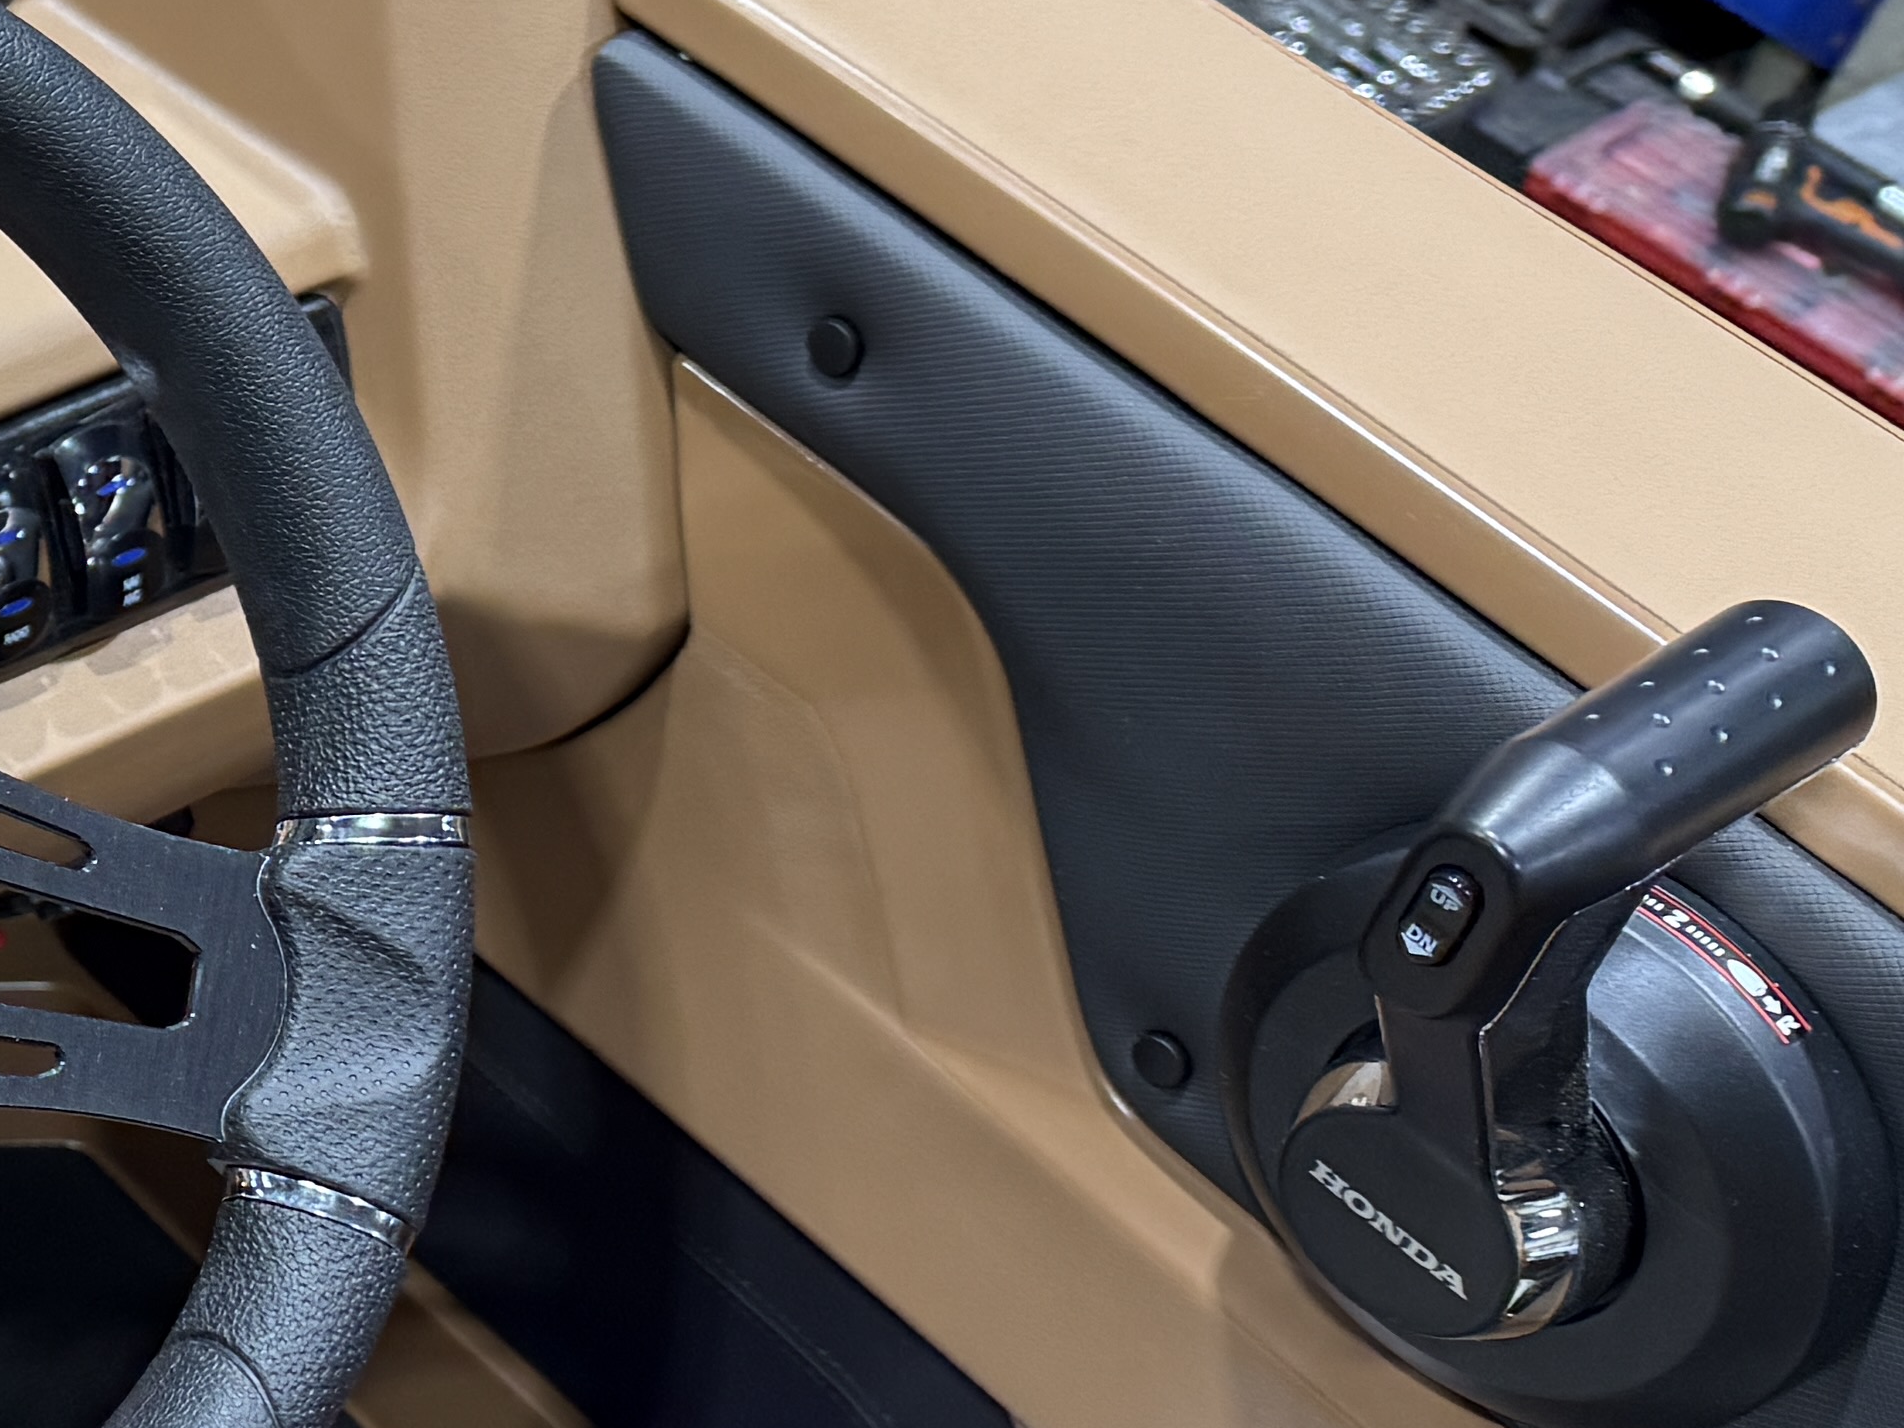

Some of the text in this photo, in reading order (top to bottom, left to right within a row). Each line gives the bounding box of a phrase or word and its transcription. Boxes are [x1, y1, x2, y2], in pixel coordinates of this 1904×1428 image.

[1430, 887, 1460, 911] UP
[1406, 923, 1439, 952] DN
[1308, 1159, 1468, 1301] HONDA
